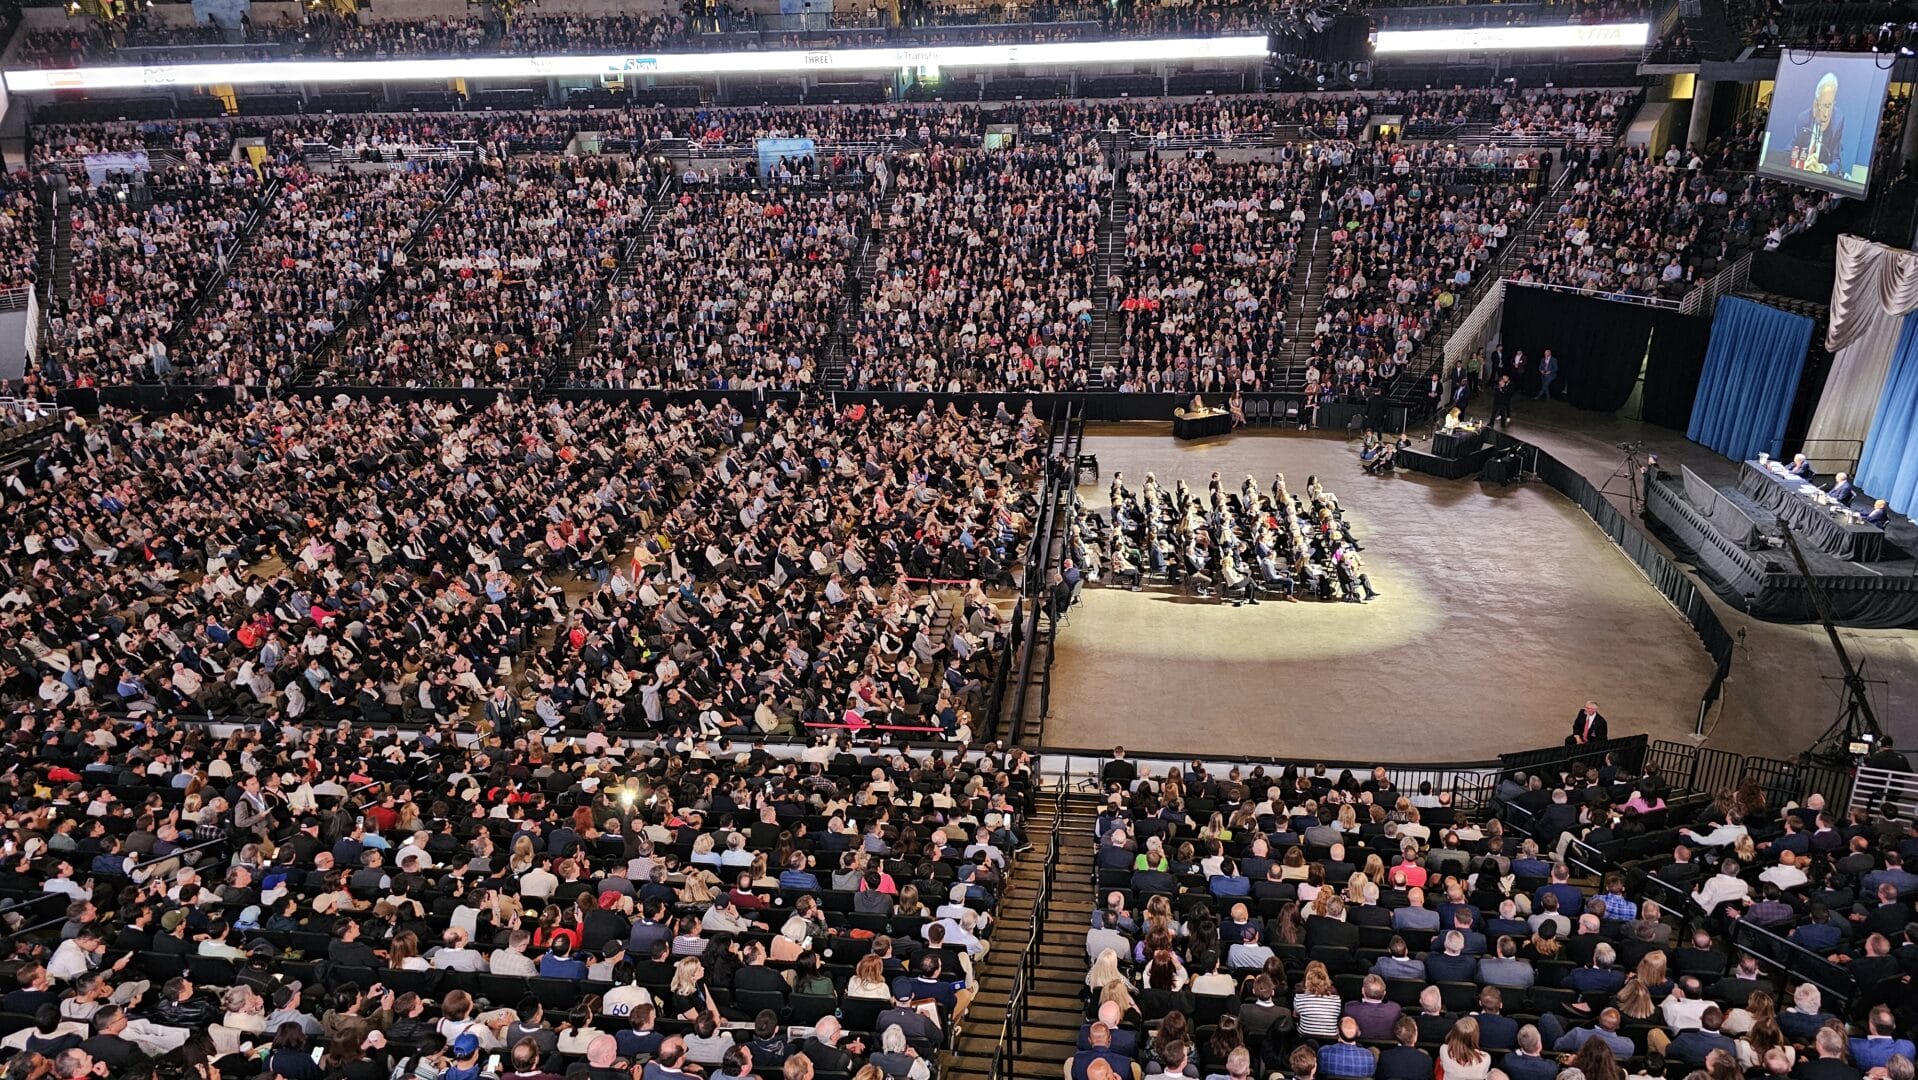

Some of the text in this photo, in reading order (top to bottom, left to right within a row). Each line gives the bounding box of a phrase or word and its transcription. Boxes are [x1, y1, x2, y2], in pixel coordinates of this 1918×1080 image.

[625, 58, 658, 71] Shaw
[804, 55, 829, 64] THREE
[612, 1003, 629, 1016] 60
